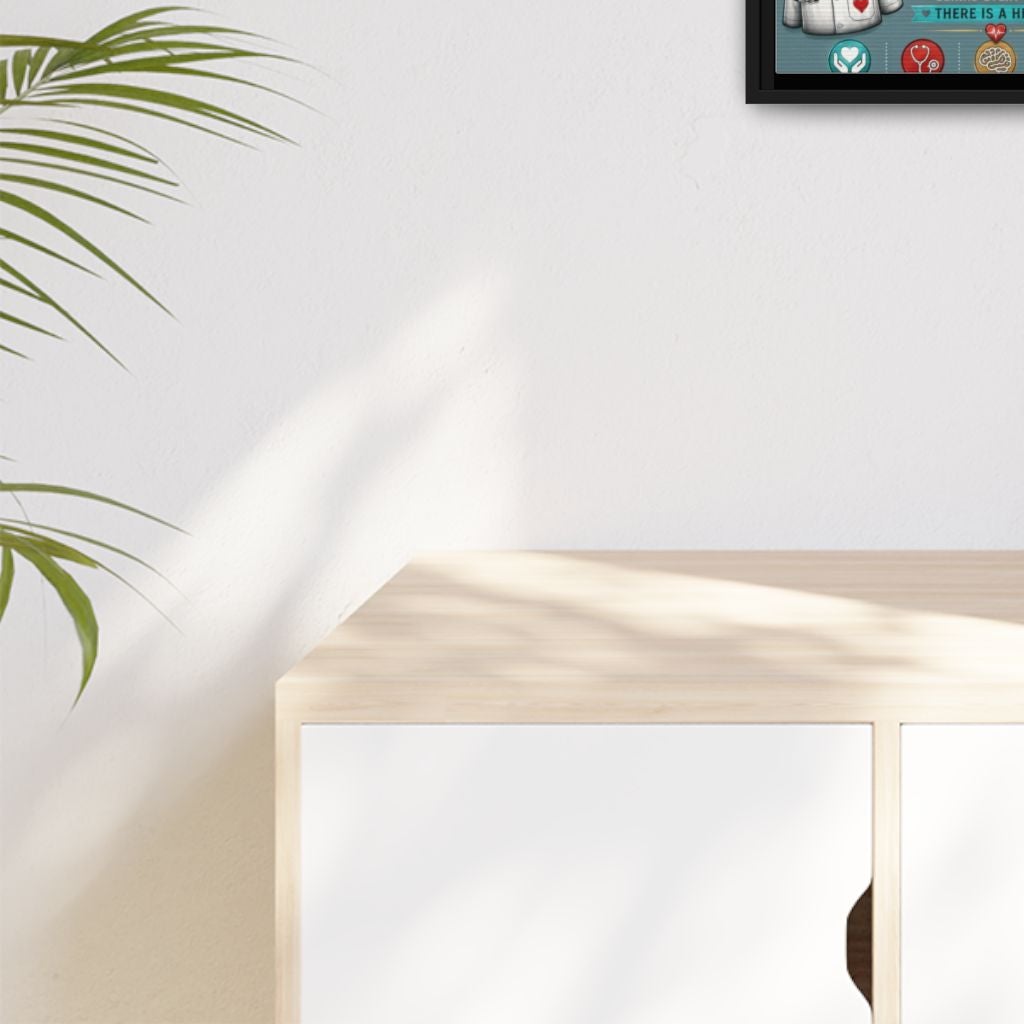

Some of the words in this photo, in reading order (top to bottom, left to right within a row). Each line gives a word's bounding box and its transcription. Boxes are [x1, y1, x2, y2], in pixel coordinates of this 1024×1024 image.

[935, 8, 976, 19] THERE
[981, 8, 994, 19] IS
[999, 8, 1007, 19] A
